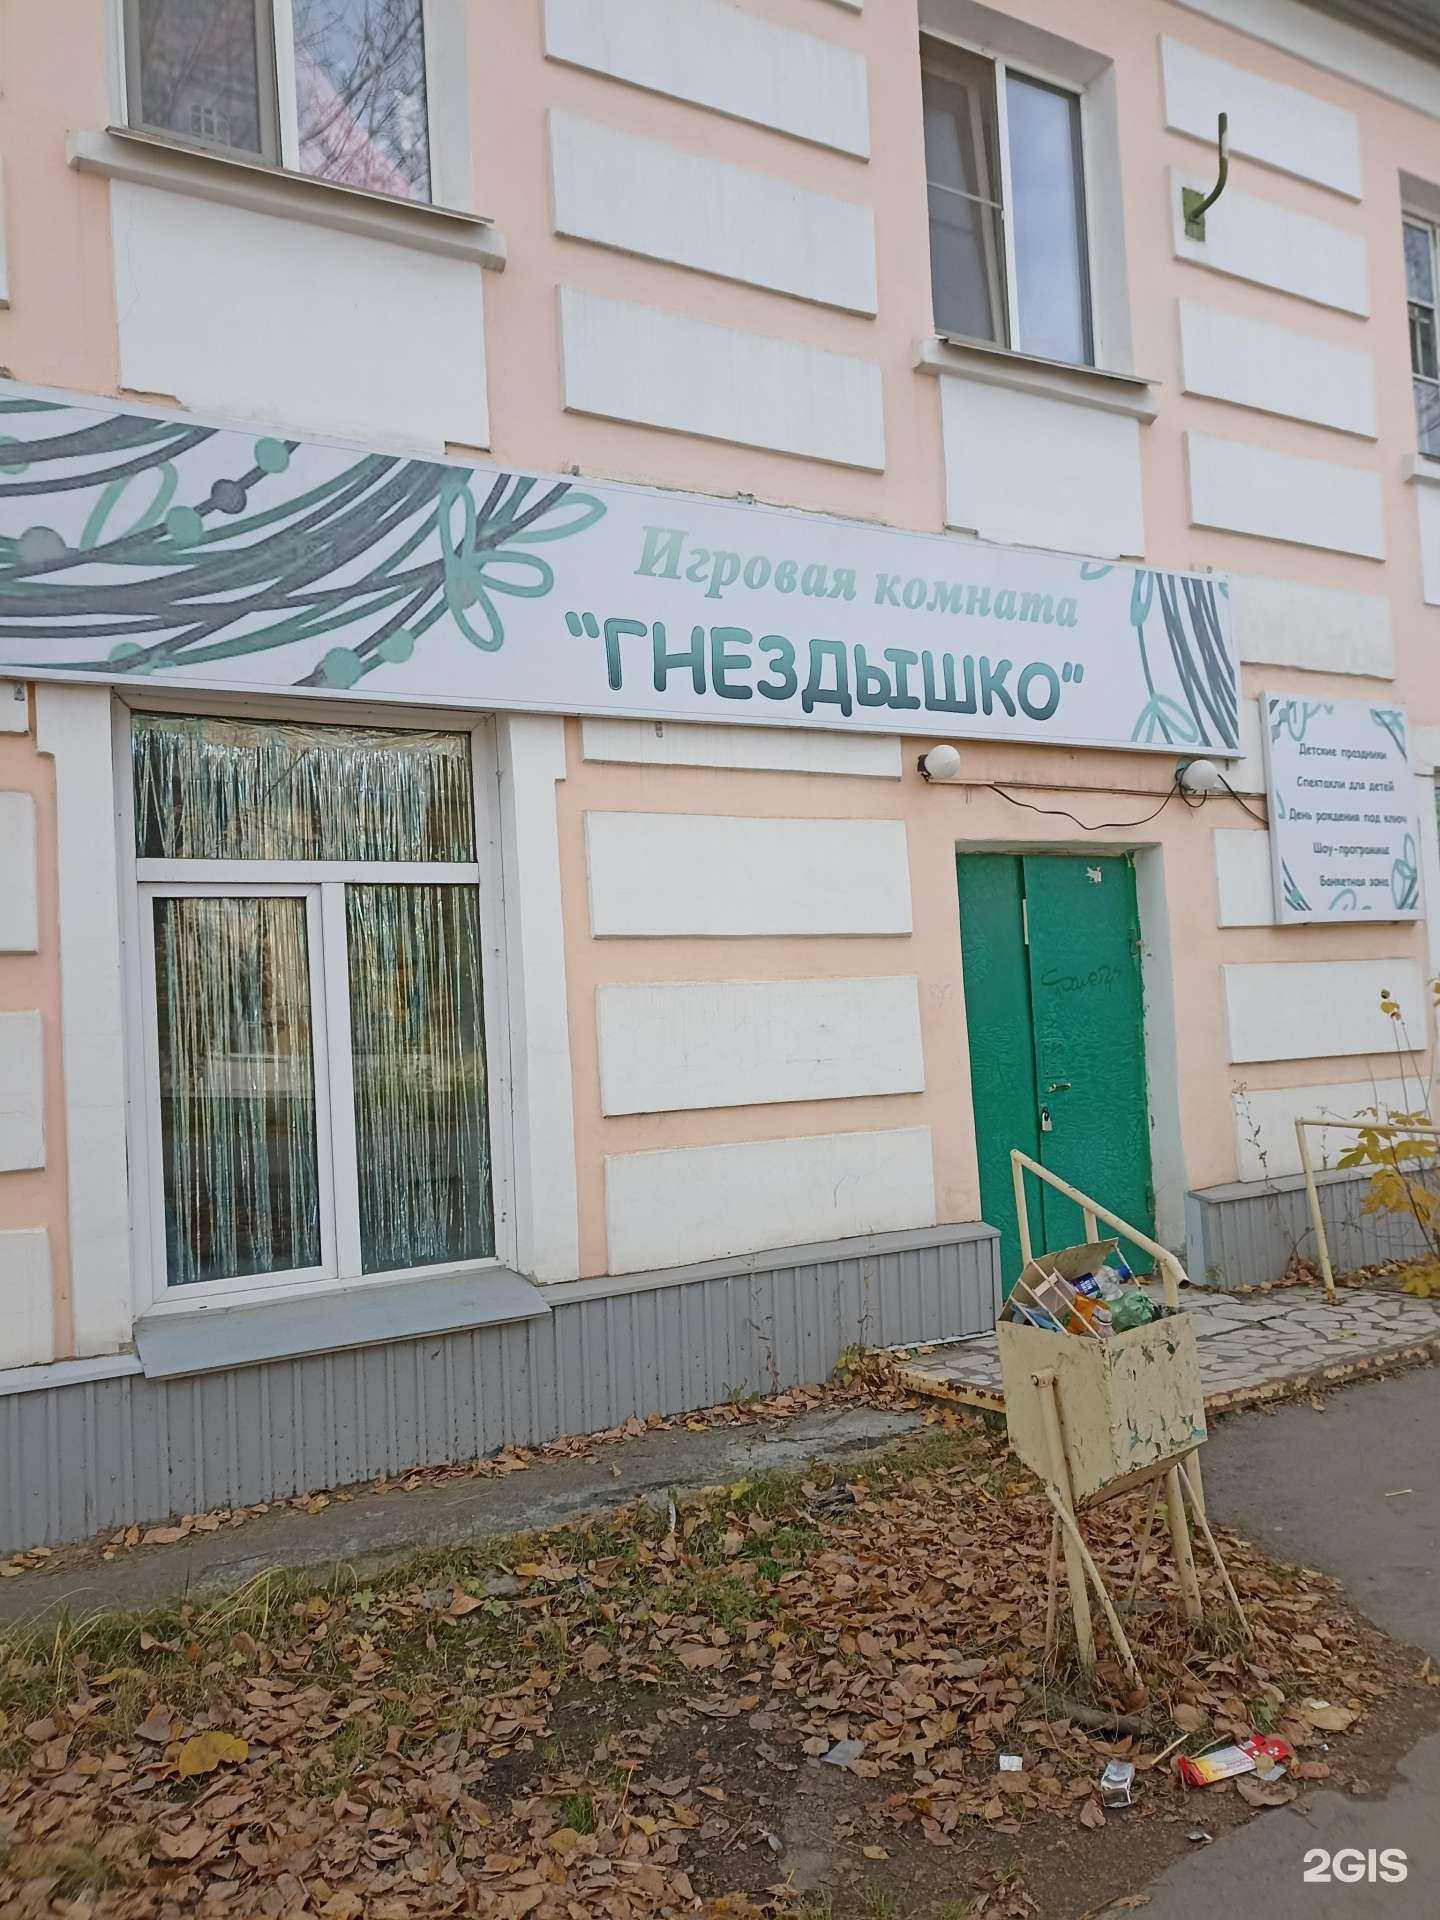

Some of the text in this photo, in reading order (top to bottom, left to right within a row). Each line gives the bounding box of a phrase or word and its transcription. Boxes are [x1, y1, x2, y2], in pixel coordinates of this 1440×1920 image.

[633, 525, 1079, 628] Игровая комната
[1299, 742, 1387, 760] Детские праздники
[1296, 775, 1395, 792] Спектакли для детей
[1289, 807, 1408, 824] День рождения под ключ
[1319, 874, 1389, 888] Банкетная зона
